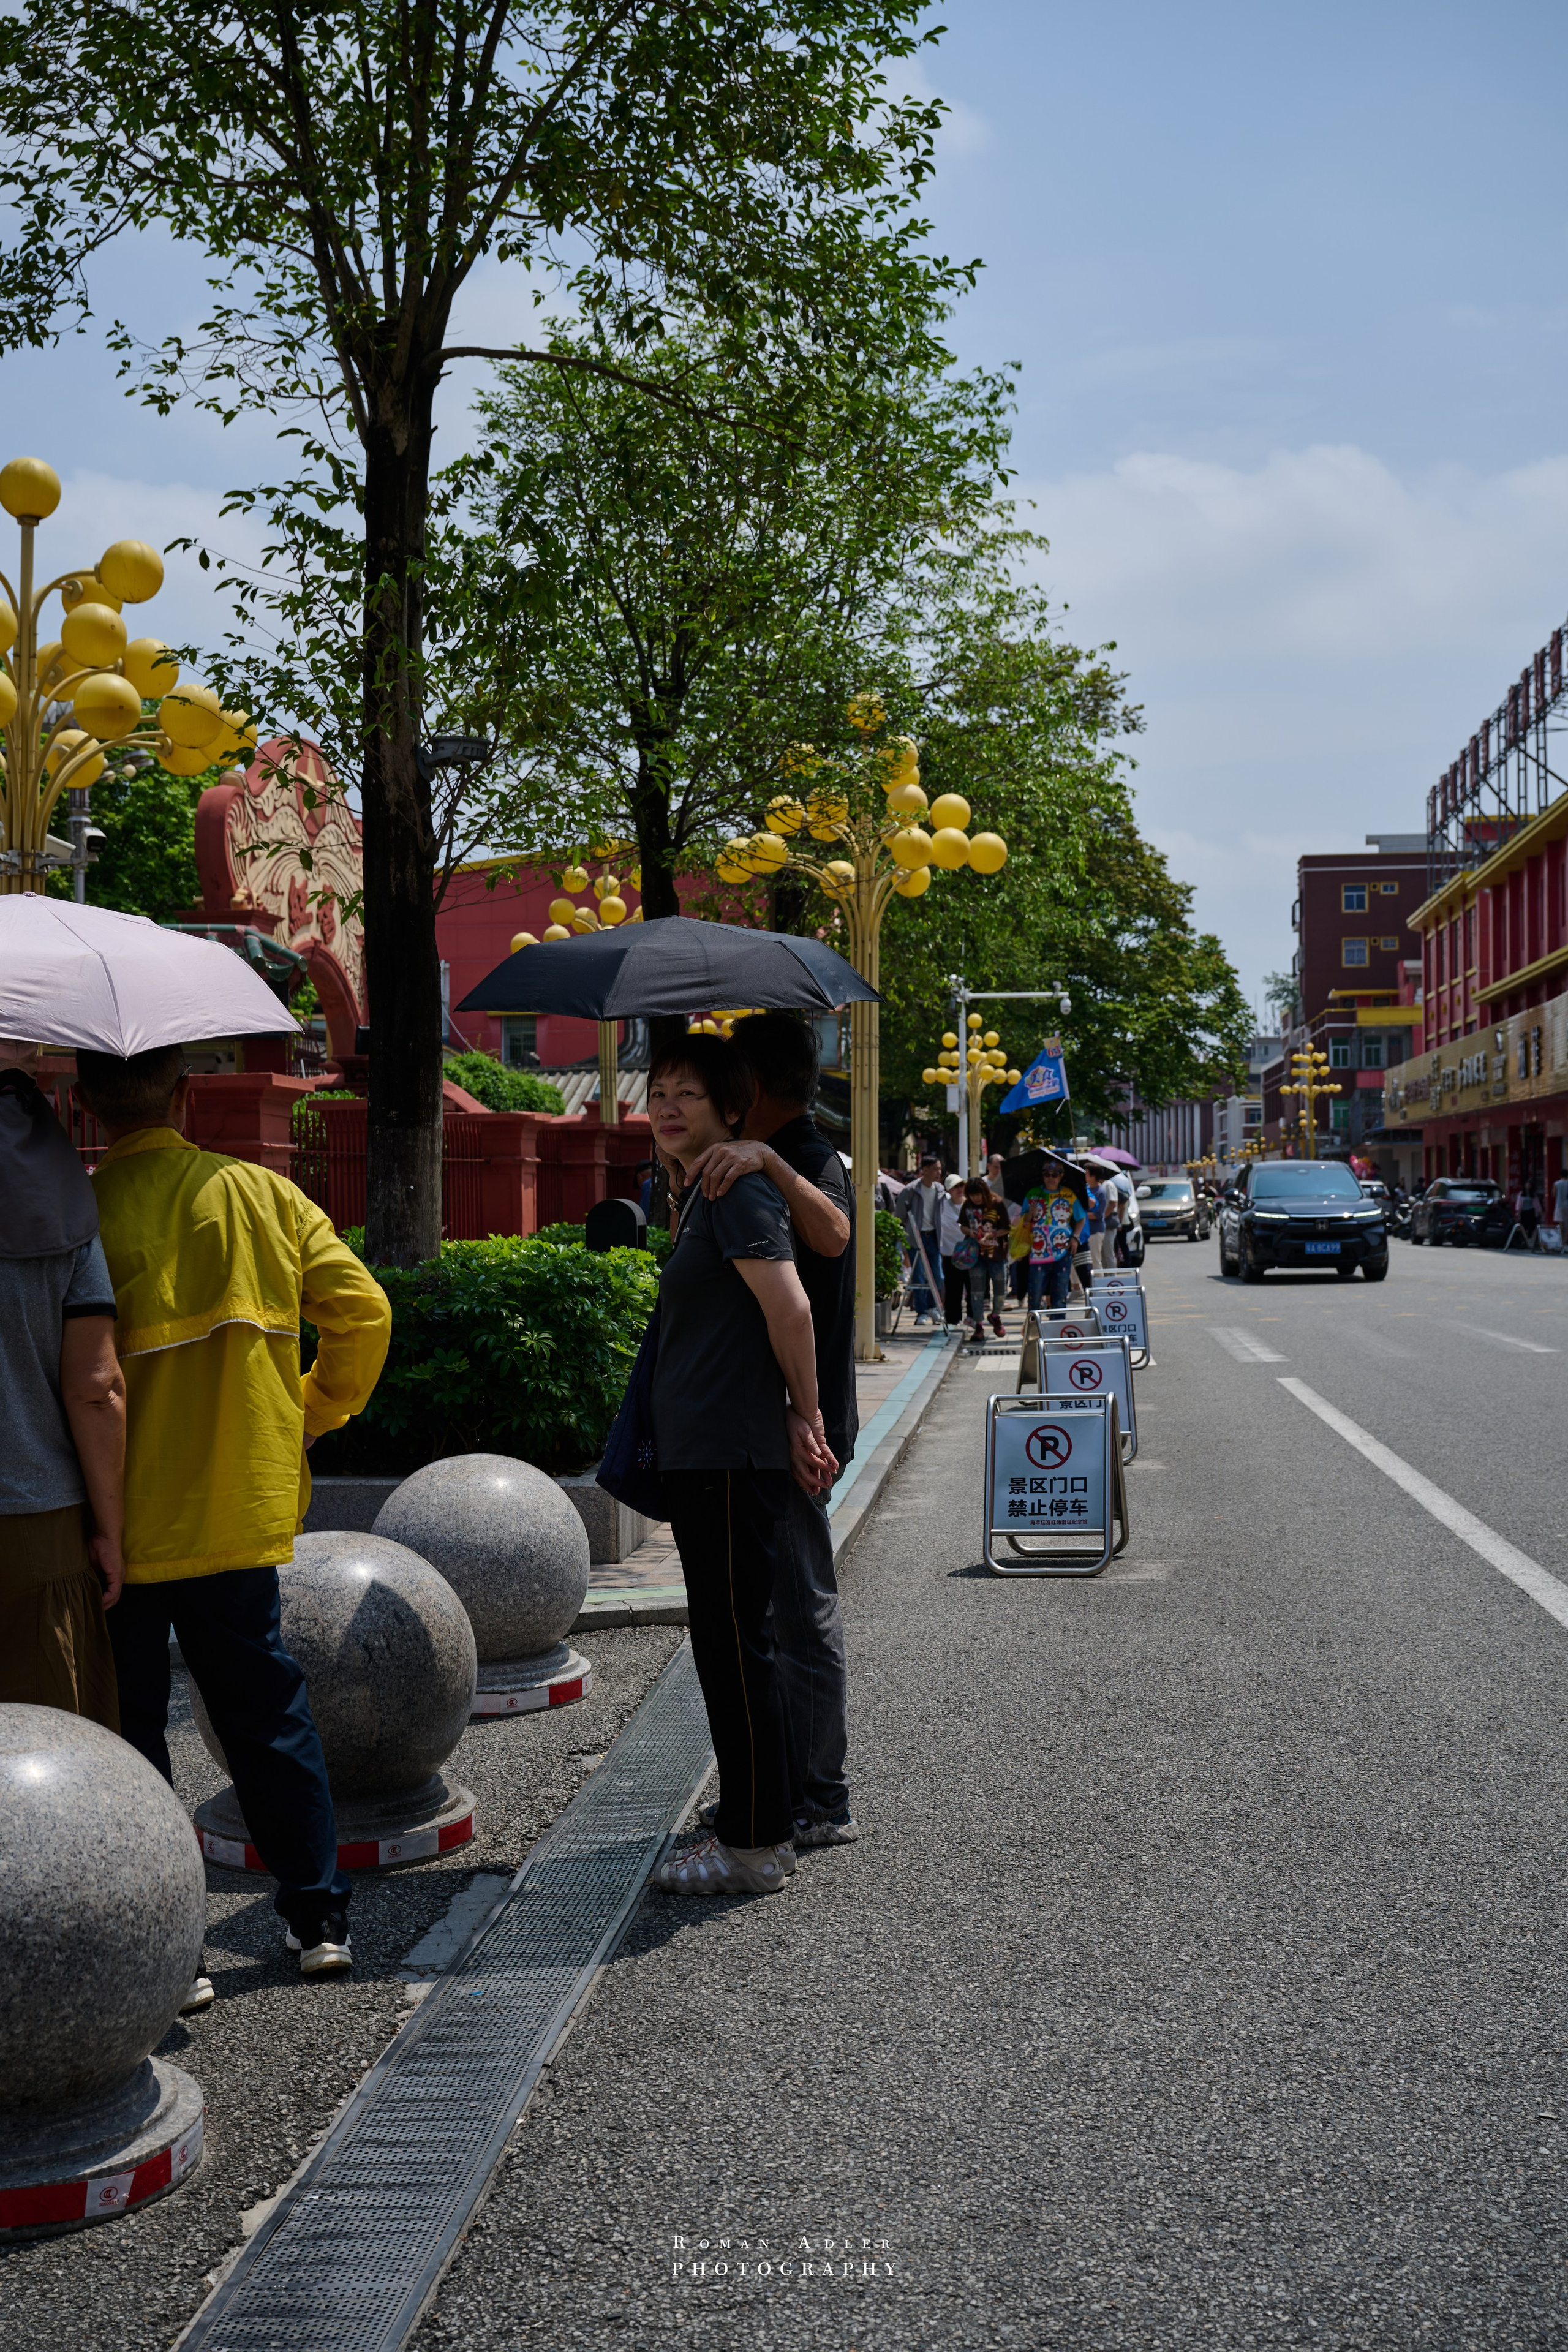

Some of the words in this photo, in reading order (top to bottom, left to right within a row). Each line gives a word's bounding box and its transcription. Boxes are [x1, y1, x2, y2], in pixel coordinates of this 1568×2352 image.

[1059, 1400, 1102, 1409] 景区门
[1008, 1476, 1088, 1495] 景区门口
[1008, 1498, 1088, 1518] 禁止停车
